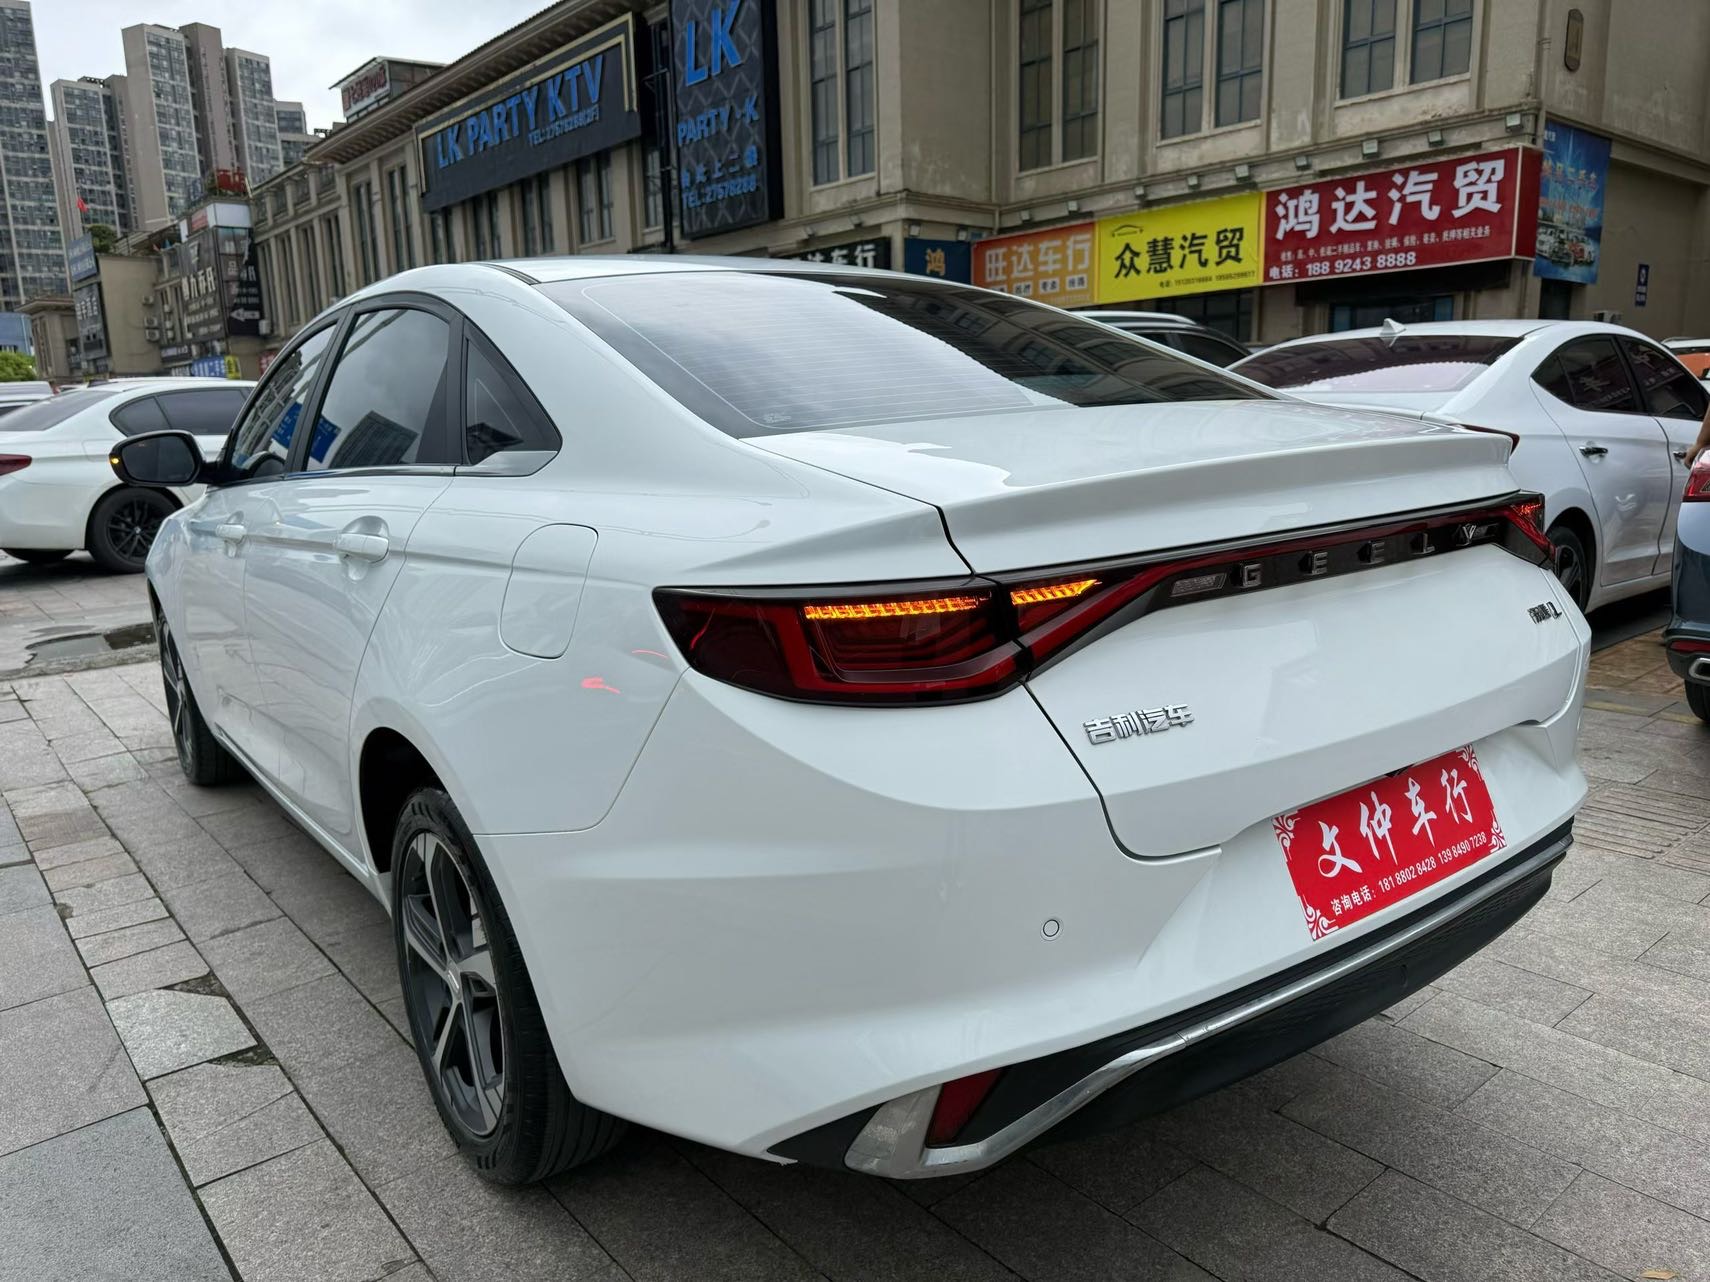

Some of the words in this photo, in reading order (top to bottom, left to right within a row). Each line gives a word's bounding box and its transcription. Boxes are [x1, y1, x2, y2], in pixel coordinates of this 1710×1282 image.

[686, 0, 743, 86] LK
[437, 123, 463, 169] LK
[466, 85, 539, 156] PARTY
[546, 54, 603, 121] KTV
[1275, 159, 1505, 240] 鸿达汽贸
[985, 234, 1091, 282] 旺达车行
[1114, 227, 1244, 279] 众慧汽贸
[1306, 261, 1330, 276] 188
[1335, 256, 1371, 273] 9243
[1376, 251, 1416, 269] 8888
[1241, 523, 1478, 589] GEELY
[1083, 703, 1195, 745] 吉利汽车
[1318, 768, 1473, 878] 文仲车行
[1378, 877, 1395, 893] 181
[1396, 866, 1417, 886] 8802
[1416, 856, 1437, 876] 8428
[1437, 849, 1452, 865] 139
[1452, 840, 1472, 858] 8490
[1470, 832, 1487, 849] 7238
